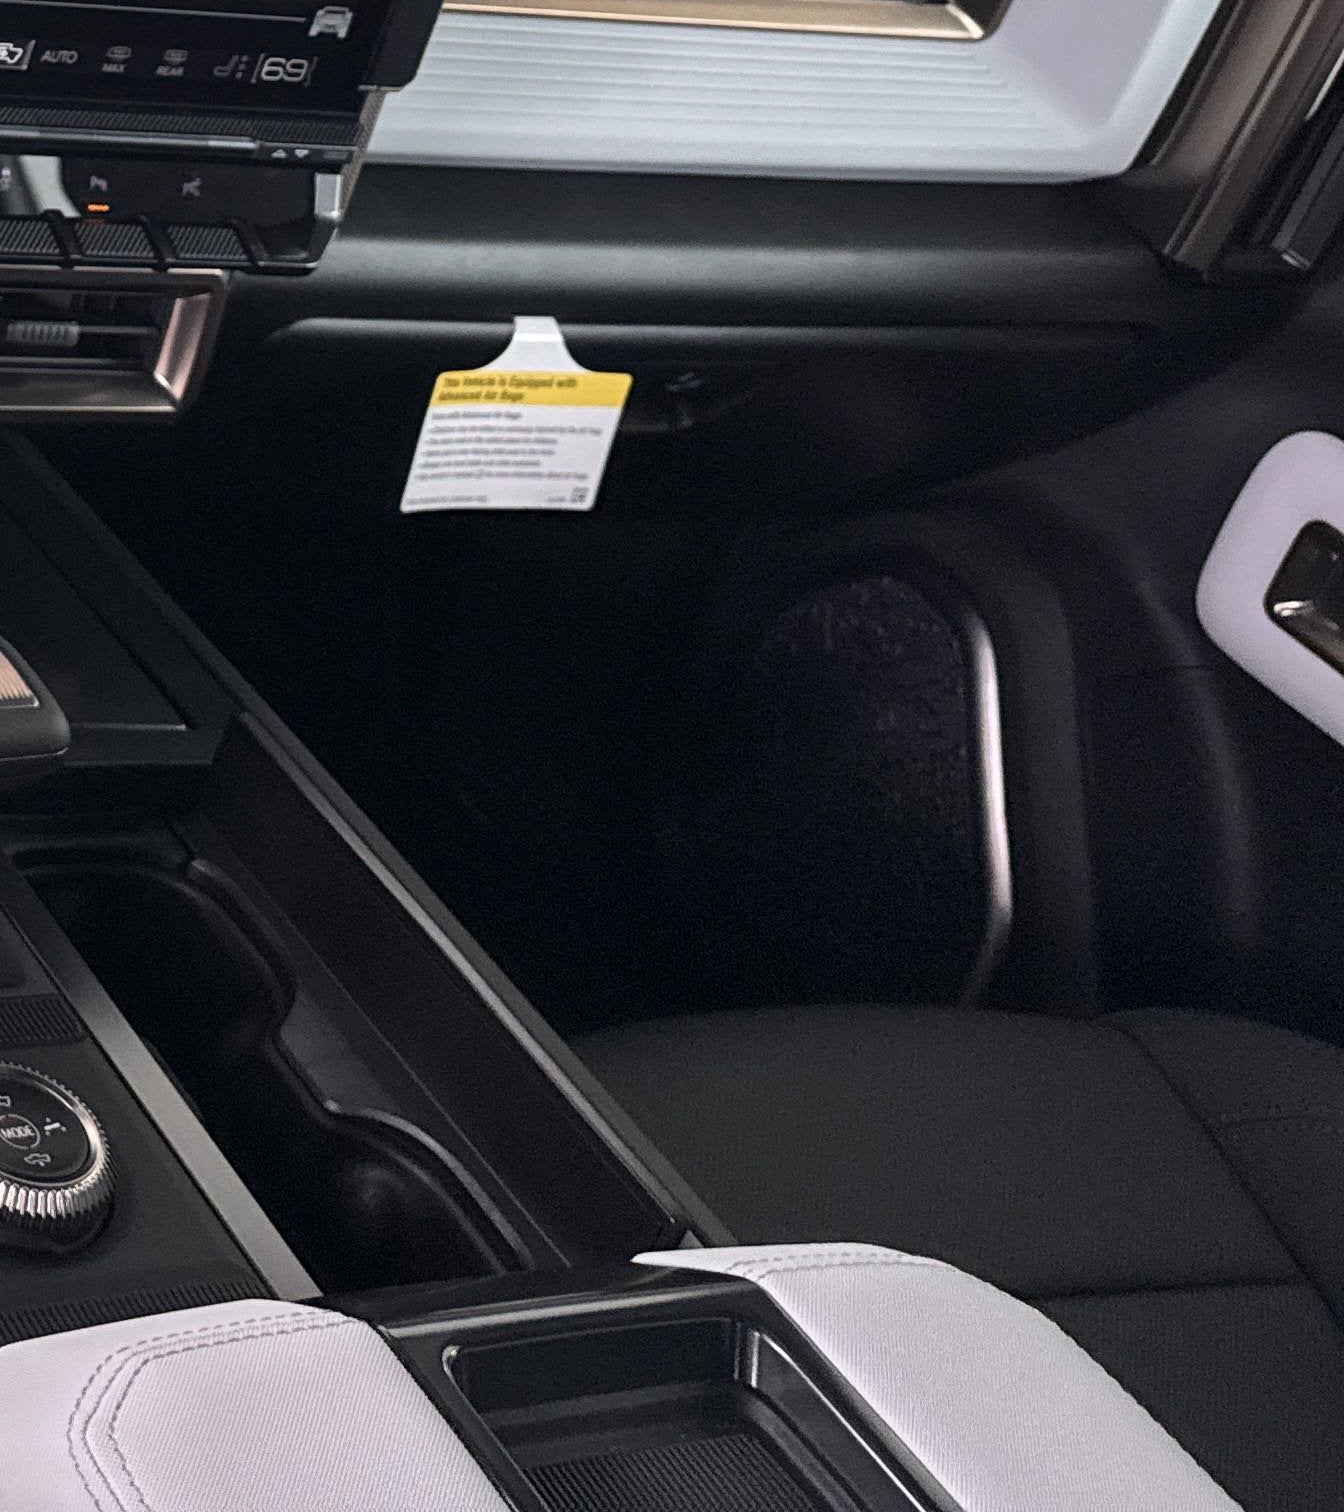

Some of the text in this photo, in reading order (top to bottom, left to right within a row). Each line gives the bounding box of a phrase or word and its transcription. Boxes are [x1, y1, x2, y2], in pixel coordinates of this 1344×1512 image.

[39, 50, 79, 65] AUTO
[155, 65, 185, 77] REAR
[260, 56, 310, 82] 69
[0, 1124, 36, 1140] MODE
